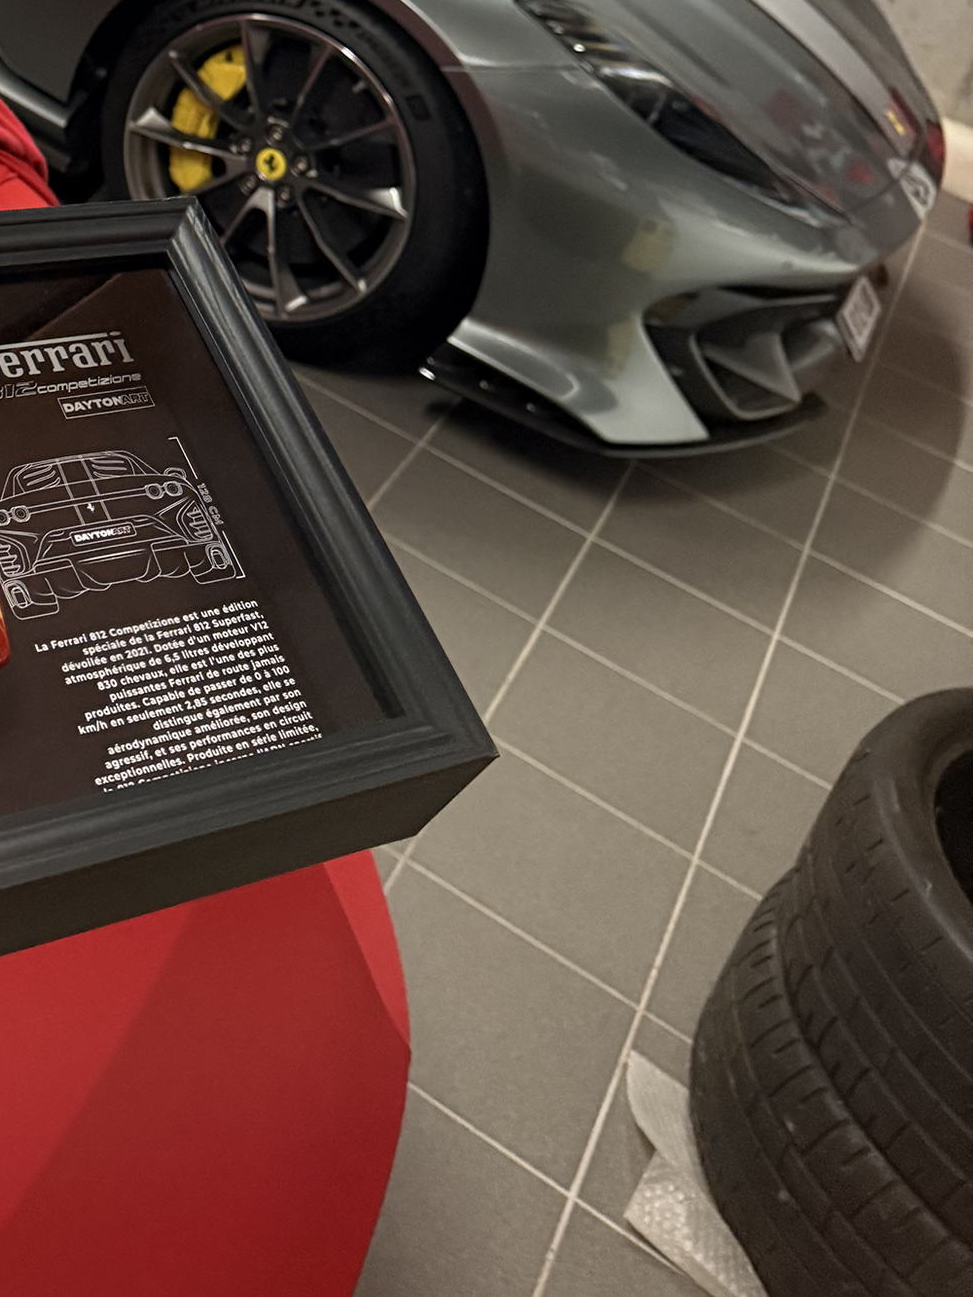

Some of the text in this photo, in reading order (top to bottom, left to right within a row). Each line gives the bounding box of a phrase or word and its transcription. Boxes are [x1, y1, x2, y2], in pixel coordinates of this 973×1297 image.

[62, 391, 149, 413] DAYTONART
[34, 600, 258, 652] La Ferrari 812 Competizione est une édition
[61, 620, 269, 672] dévoilée en 2021. Dotée d'un moteur V12
[82, 611, 264, 655] spéciale de la Ferrari 812 Superfast,
[64, 632, 274, 684] atmosphérique de 6,5 litres développant
[97, 644, 279, 690] 830 chevaux, elle est l'une des plus
[109, 654, 285, 702] puissantes Ferrari de route jamais
[77, 678, 295, 734] km/h en seulement 2,85 secondes, elle se
[84, 665, 290, 721] produites. Capable de passer de 0 à 100
[153, 689, 301, 730] distingue également par son
[104, 750, 153, 769] agressif,
[154, 747, 167, 757] et
[168, 743, 187, 753] ses
[189, 724, 262, 750] performances
[263, 721, 277, 730] en
[279, 711, 313, 726] circuit
[107, 701, 307, 755] aérodynamique améliorée, son design
[94, 757, 185, 785] exceptionnelles.
[186, 745, 233, 762] Produite
[235, 741, 249, 750] en
[251, 733, 277, 746] série
[278, 724, 319, 739] limitée,
